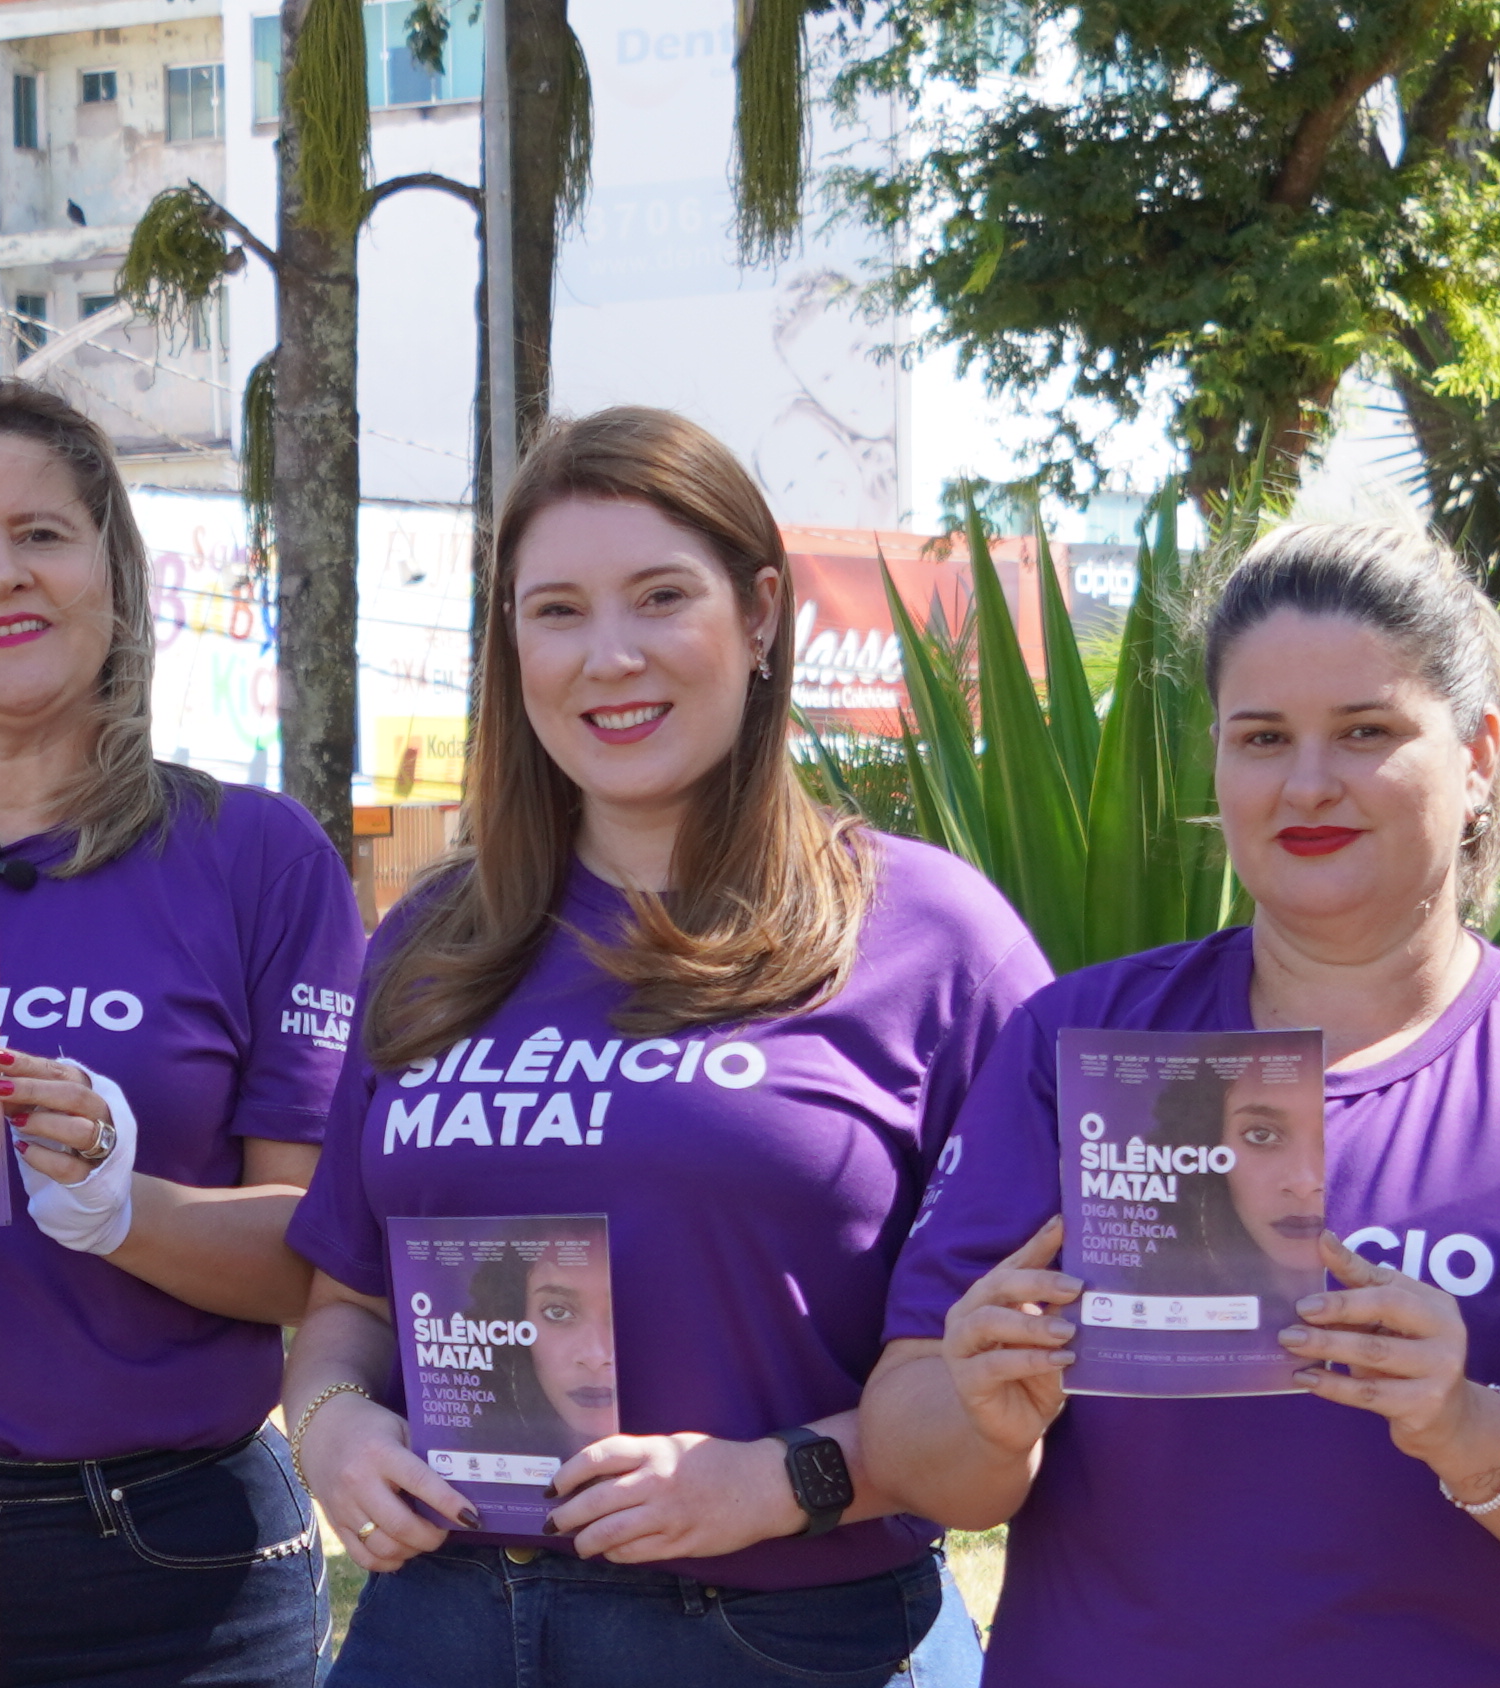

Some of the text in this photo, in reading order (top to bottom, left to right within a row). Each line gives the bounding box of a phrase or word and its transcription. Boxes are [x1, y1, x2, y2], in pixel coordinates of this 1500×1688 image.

[616, 21, 735, 65] Dent
[427, 735, 466, 760] Koda
[291, 982, 356, 1017] CLEID
[280, 1010, 351, 1043] HILÁR
[383, 1091, 612, 1155] MATA!
[1080, 1113, 1105, 1140] O
[1080, 1136, 1236, 1174] SILÊNCIO
[1081, 1170, 1177, 1203] MATA!
[1082, 1204, 1158, 1220] DIGA NÃO
[1082, 1218, 1177, 1239] À VIOLÊNCIA
[1082, 1236, 1157, 1253] CONTRA A
[1082, 1252, 1143, 1268] MULHER.
[411, 1292, 431, 1316] O
[413, 1312, 538, 1346] SILÊNCIO
[416, 1343, 493, 1371] MATA!
[420, 1372, 480, 1386] DIGA NÃO
[422, 1385, 496, 1403] À VIOLÊNCIA
[422, 1400, 482, 1415] CONTRA A
[424, 1414, 473, 1428] MULHER.
